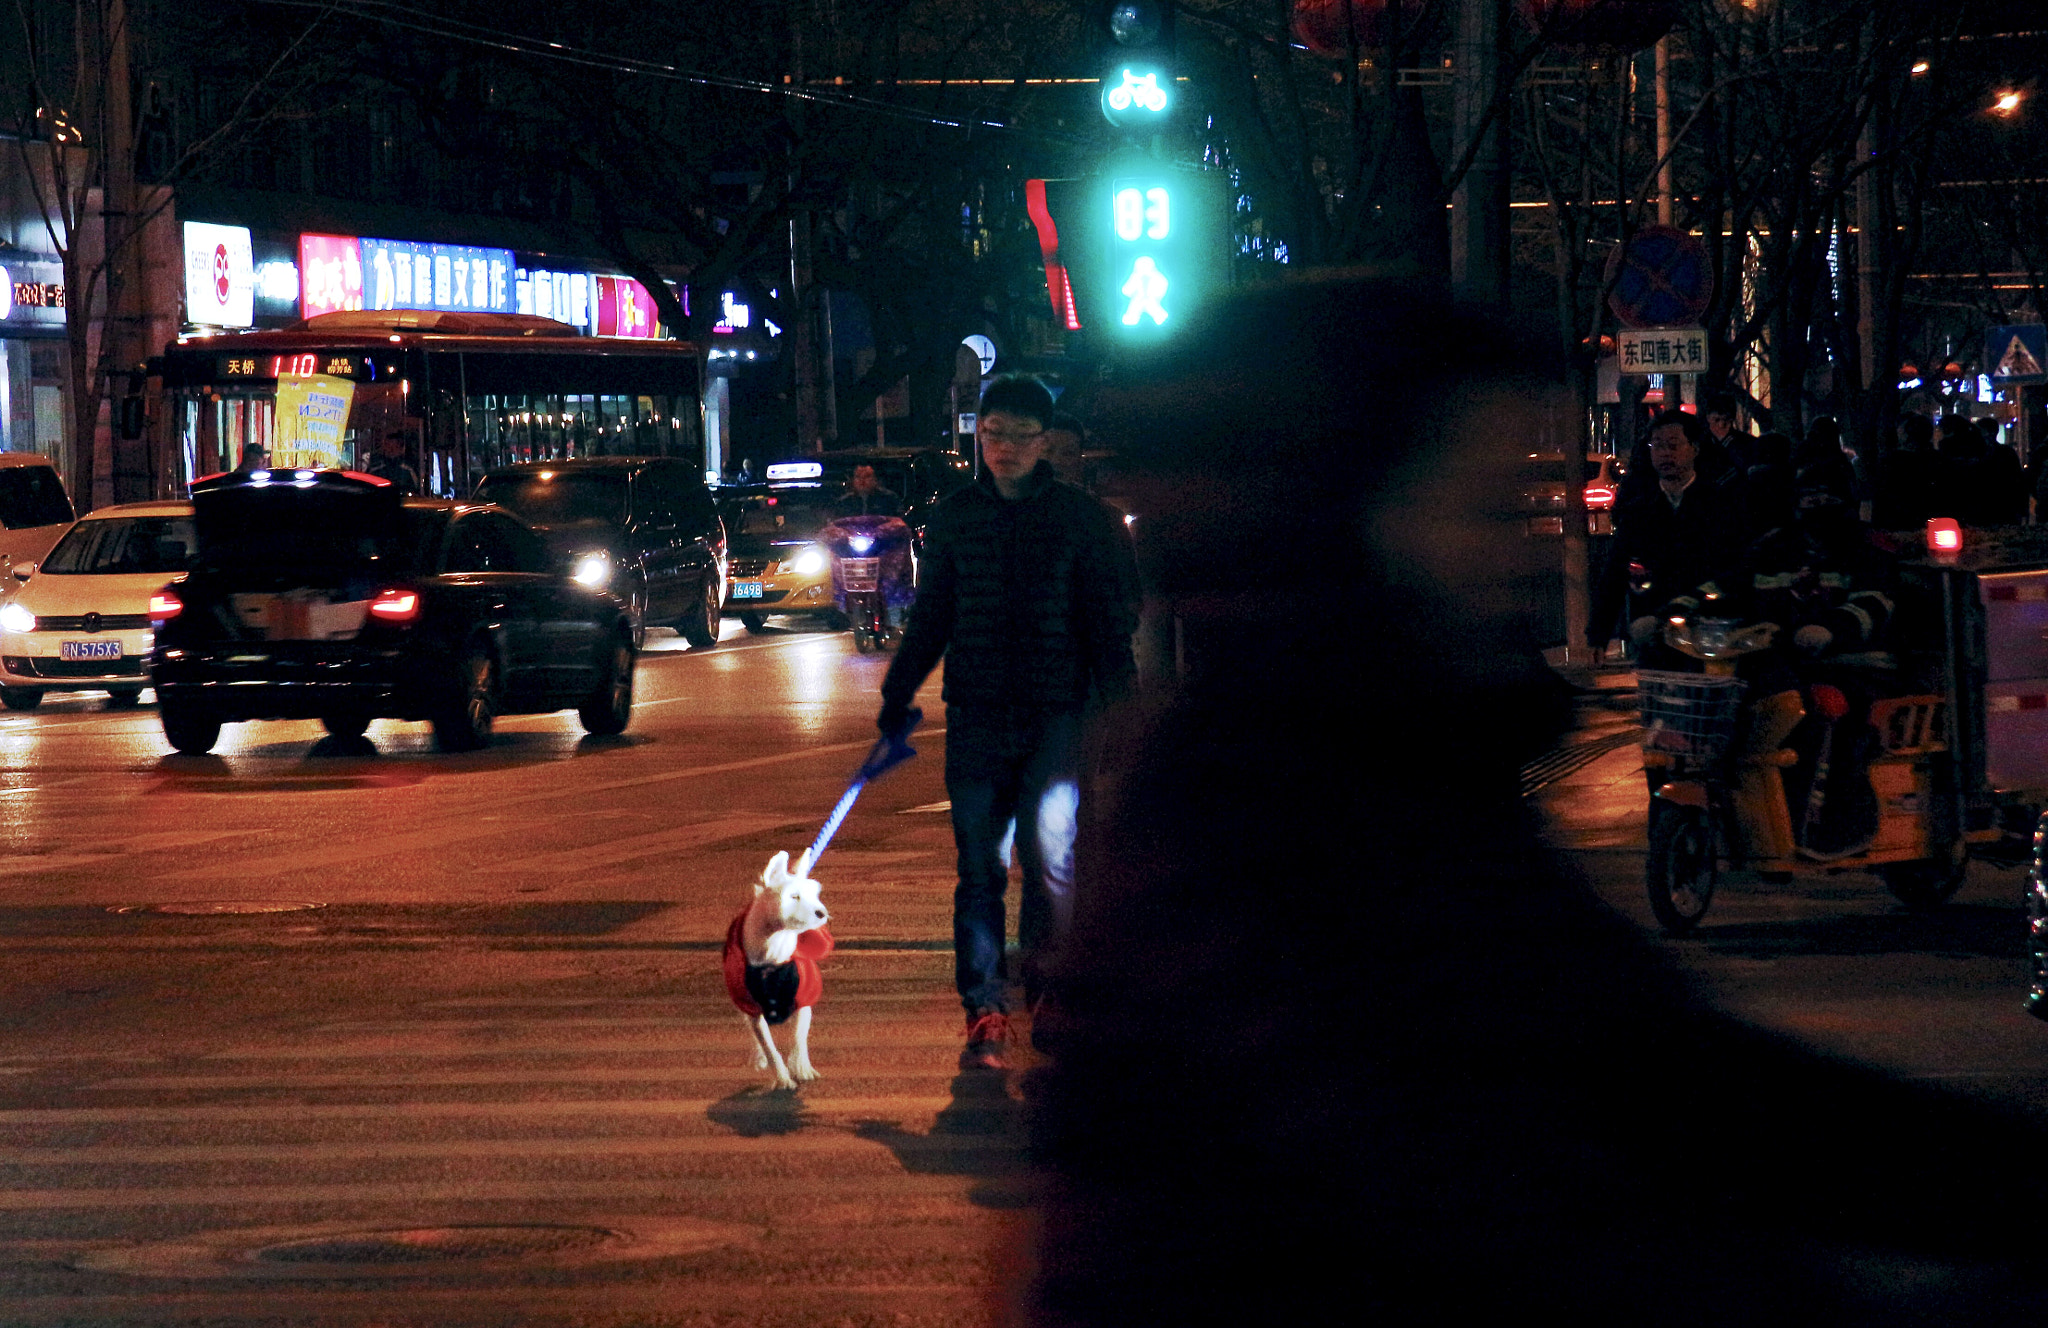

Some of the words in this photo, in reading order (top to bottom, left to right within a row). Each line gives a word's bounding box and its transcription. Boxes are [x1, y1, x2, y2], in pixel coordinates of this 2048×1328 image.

[1624, 338, 1702, 365] 东四南大街
[228, 360, 256, 375] 天桥
[274, 354, 315, 378] 110
